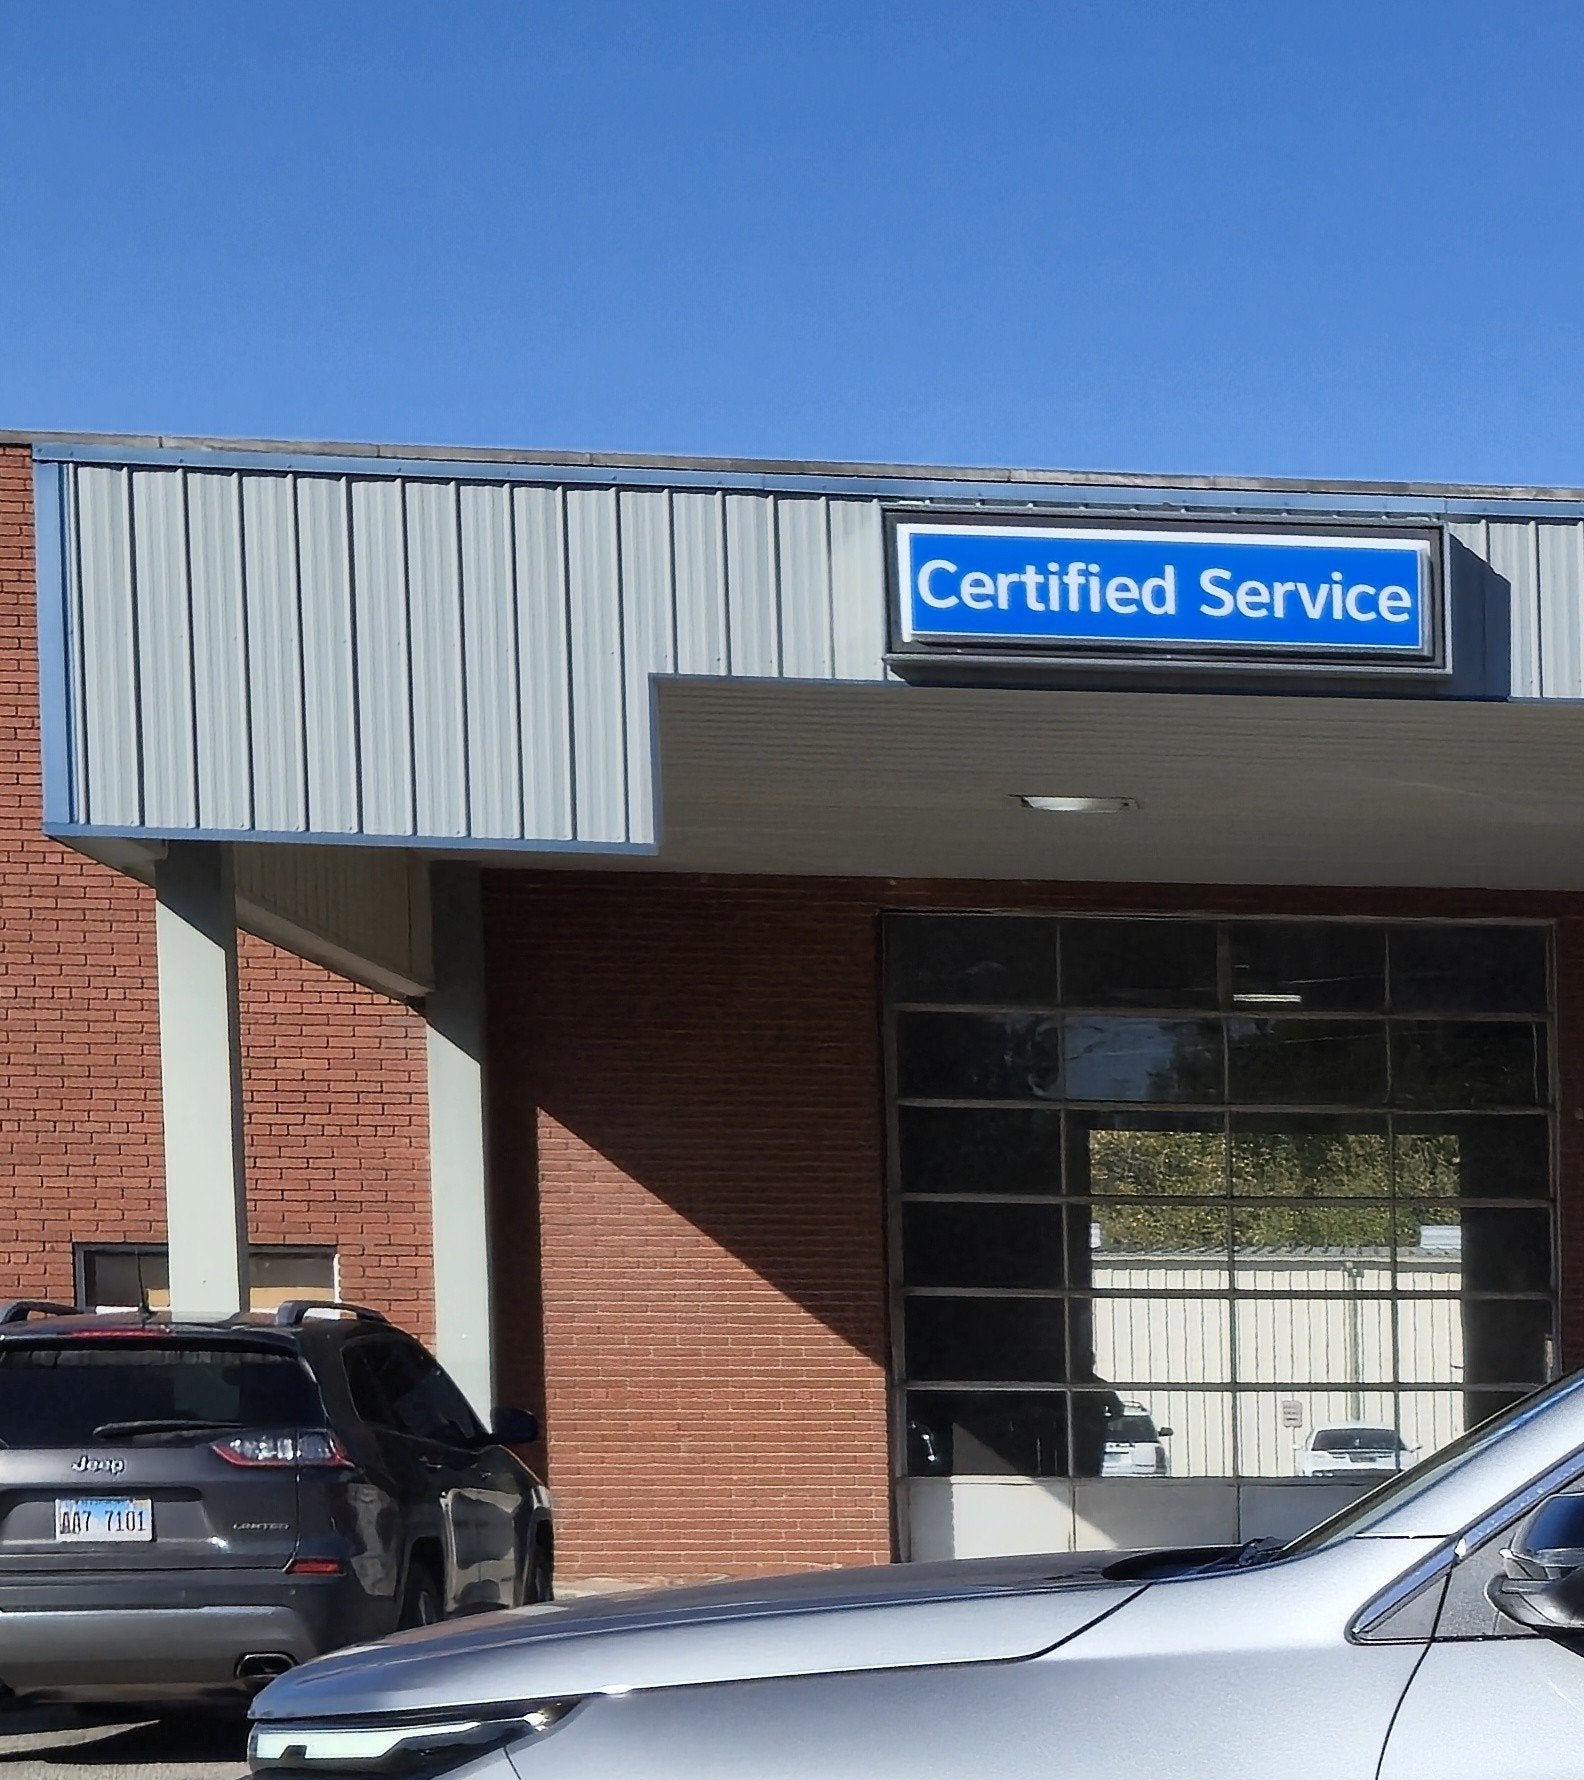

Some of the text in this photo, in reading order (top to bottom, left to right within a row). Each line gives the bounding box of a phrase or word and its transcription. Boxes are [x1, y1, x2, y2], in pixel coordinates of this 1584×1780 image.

[917, 558, 1412, 623] Certified Service
[71, 1455, 126, 1475] Jeep
[104, 1509, 146, 1532] 7101
